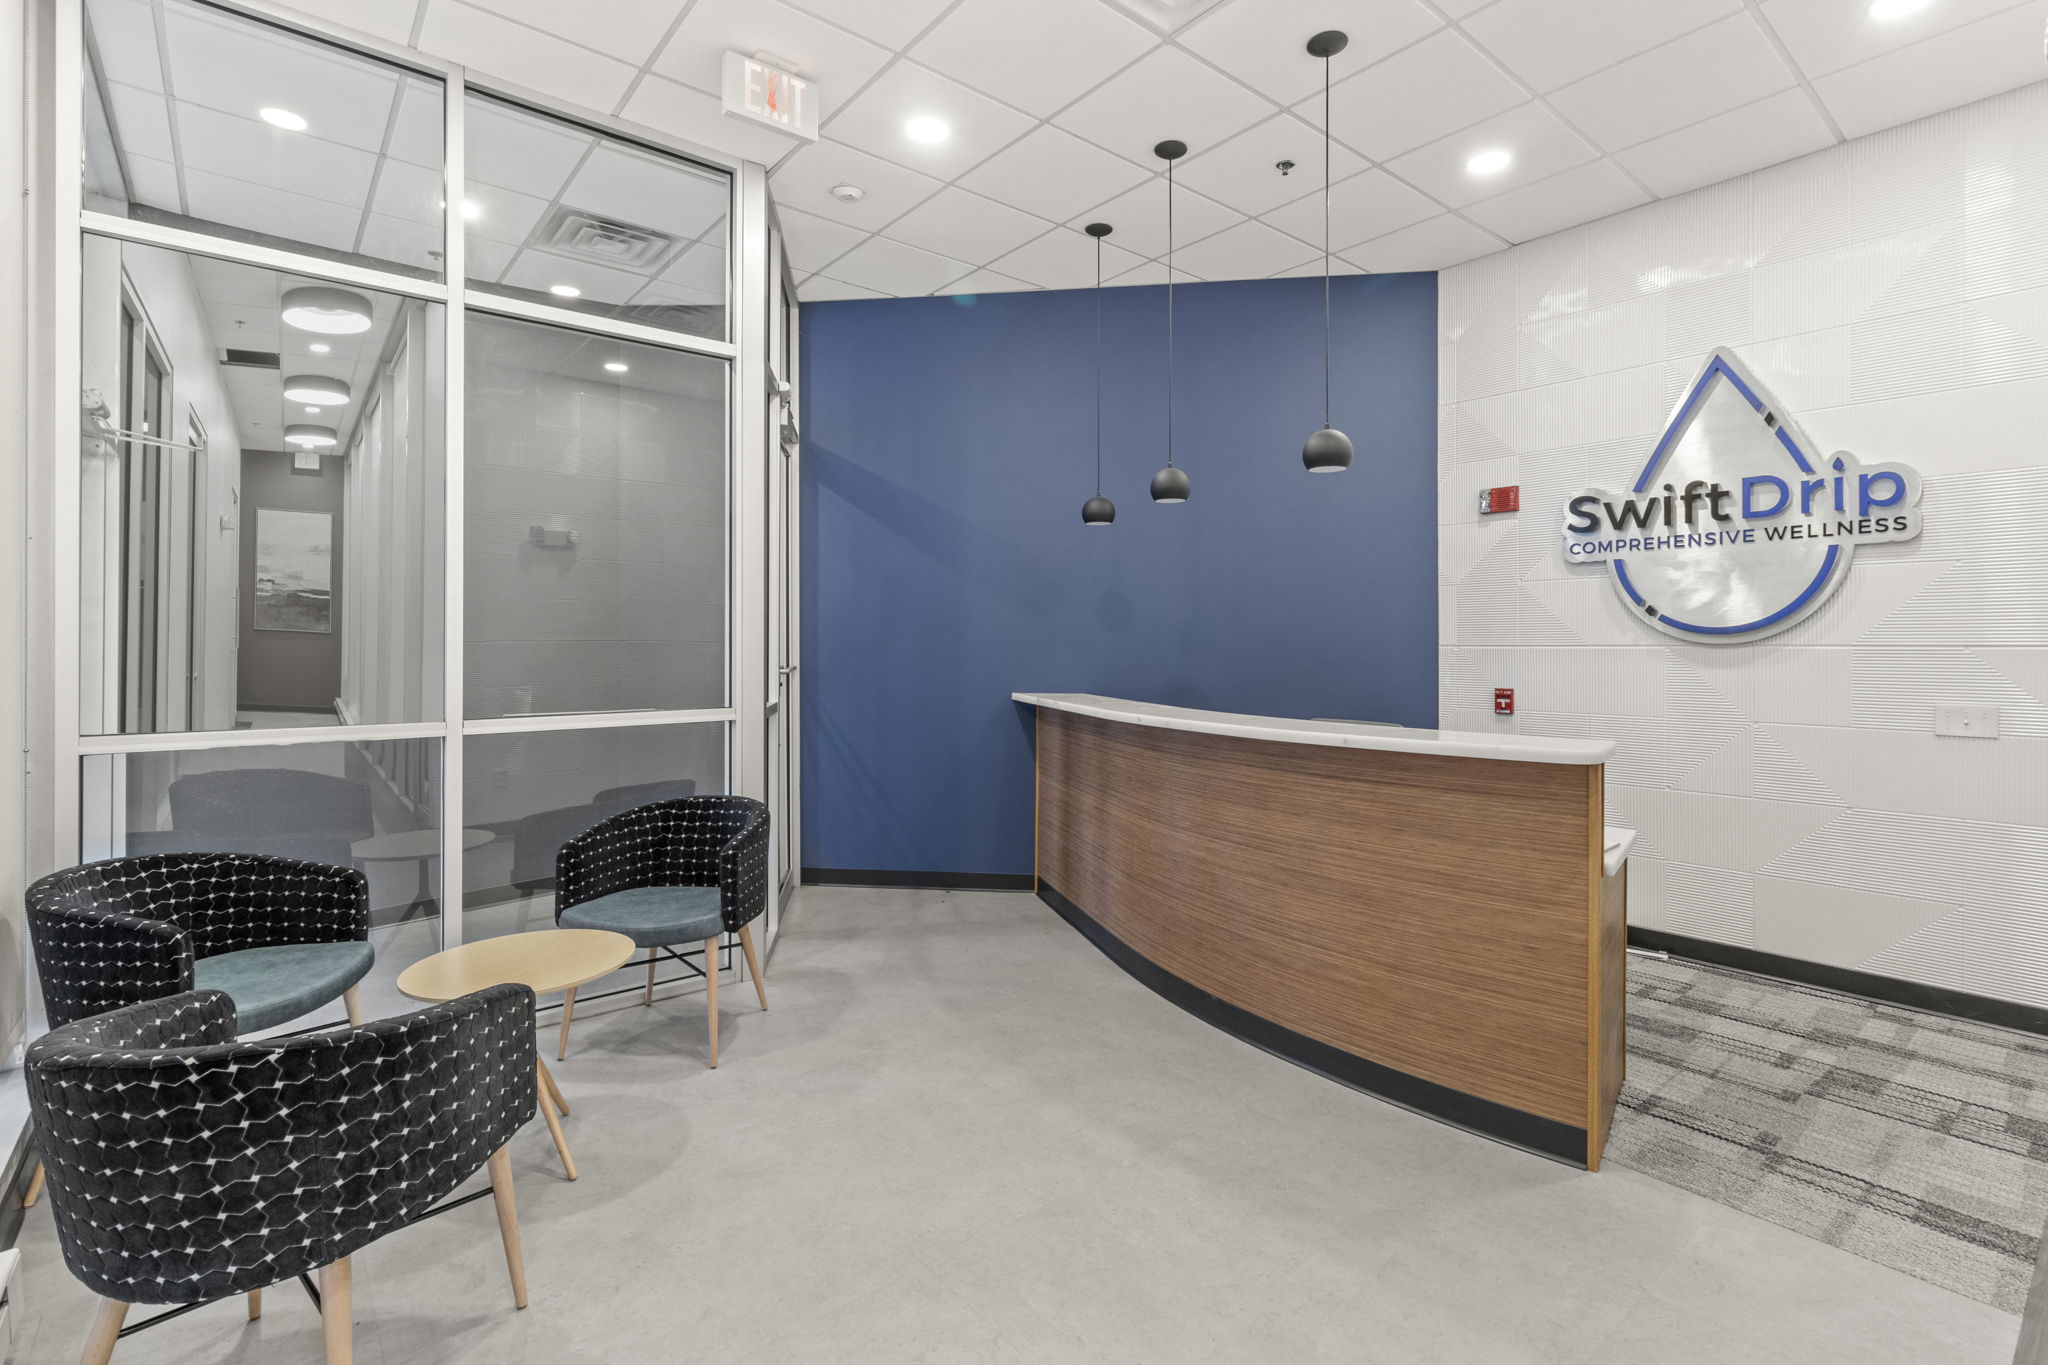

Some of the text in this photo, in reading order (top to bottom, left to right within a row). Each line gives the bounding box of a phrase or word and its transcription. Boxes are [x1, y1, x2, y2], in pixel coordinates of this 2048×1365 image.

[744, 60, 806, 129] EXIT
[1569, 515, 1908, 556] COMPREHENSIVE WELLNESS
